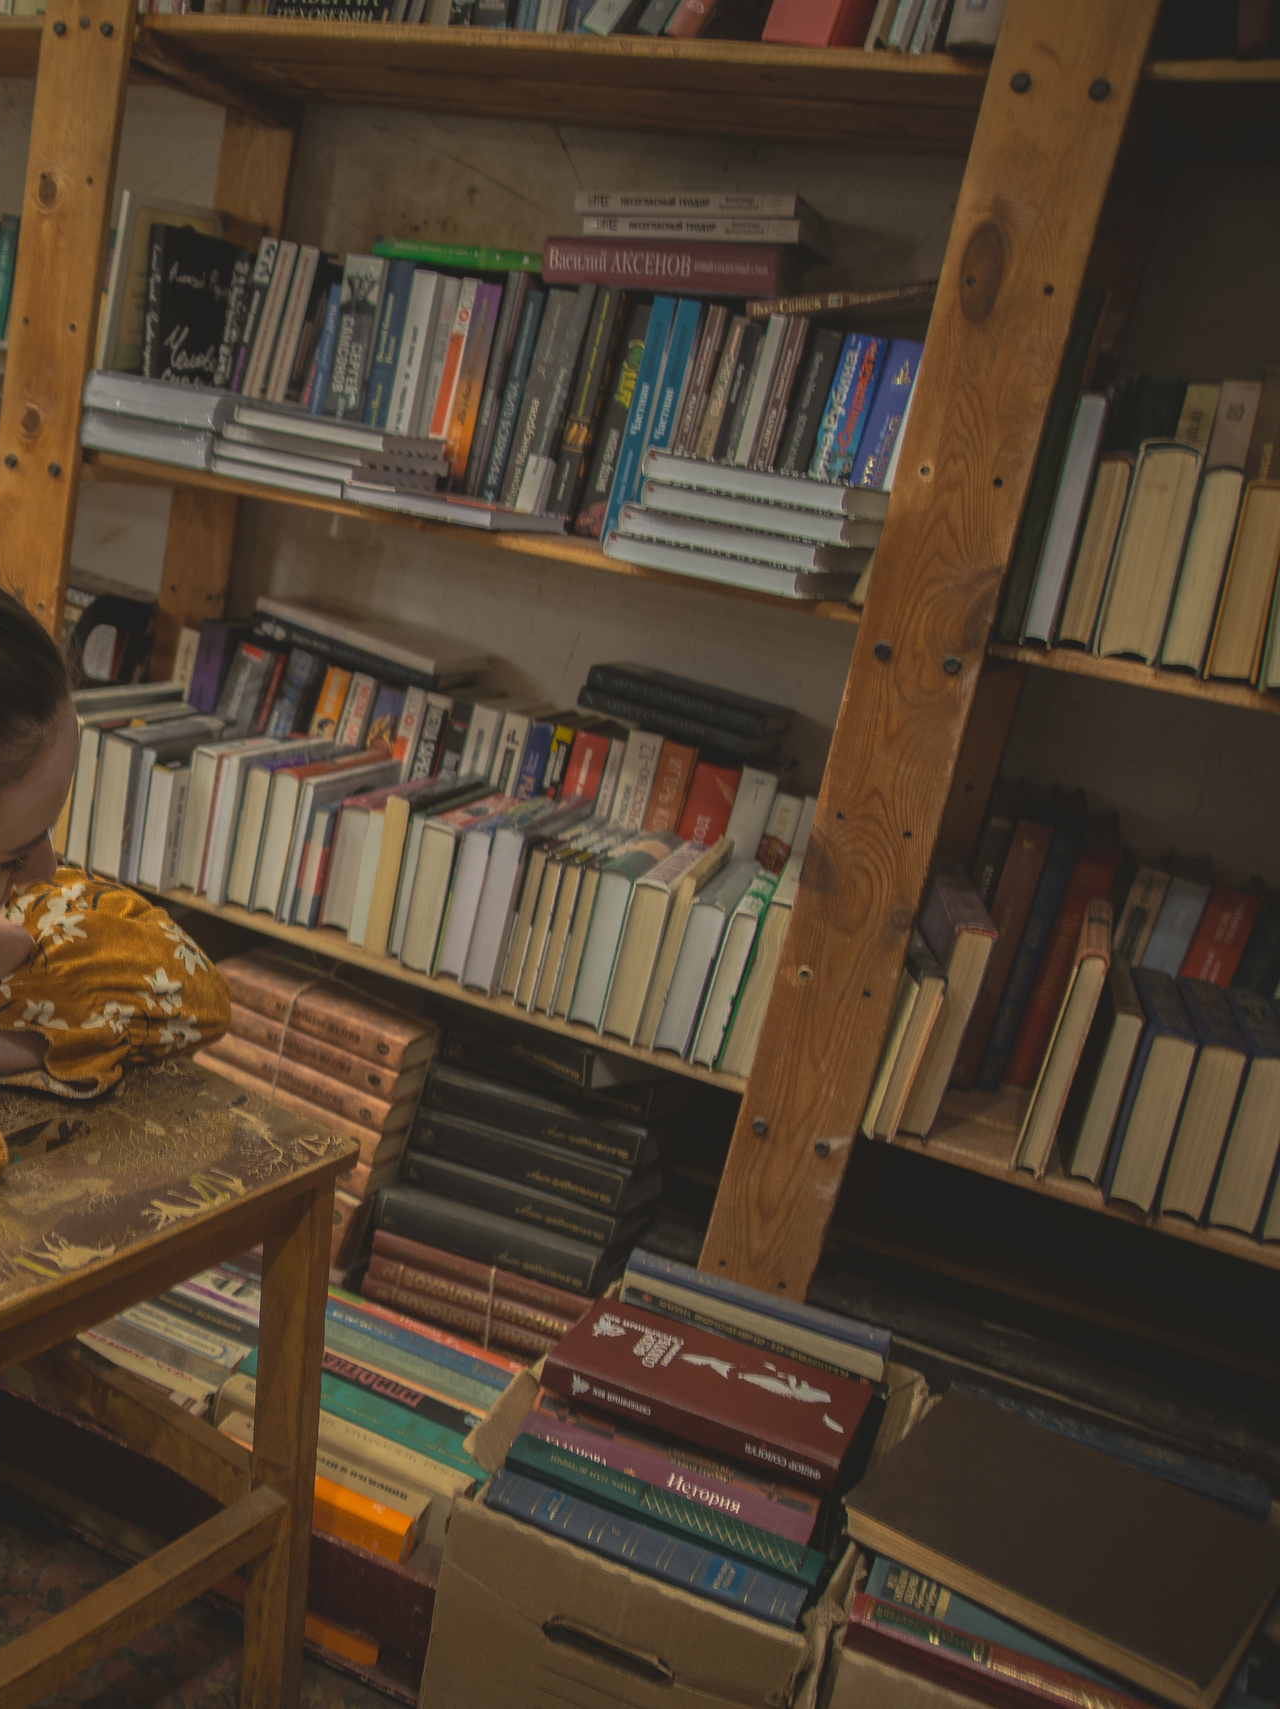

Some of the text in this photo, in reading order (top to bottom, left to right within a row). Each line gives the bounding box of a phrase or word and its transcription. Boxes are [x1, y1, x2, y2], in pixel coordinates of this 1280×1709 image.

[548, 244, 608, 273] Василий
[610, 249, 691, 278] АКСЕНОВ
[628, 380, 652, 435] Частная
[824, 349, 864, 432] Рубина
[512, 396, 544, 467] Мансурова
[651, 386, 676, 441] Частная
[503, 465, 524, 508] Мария
[741, 1441, 790, 1469] СОЛОГУБ
[786, 1458, 823, 1481] ФЕДОР
[666, 1470, 742, 1514] История
